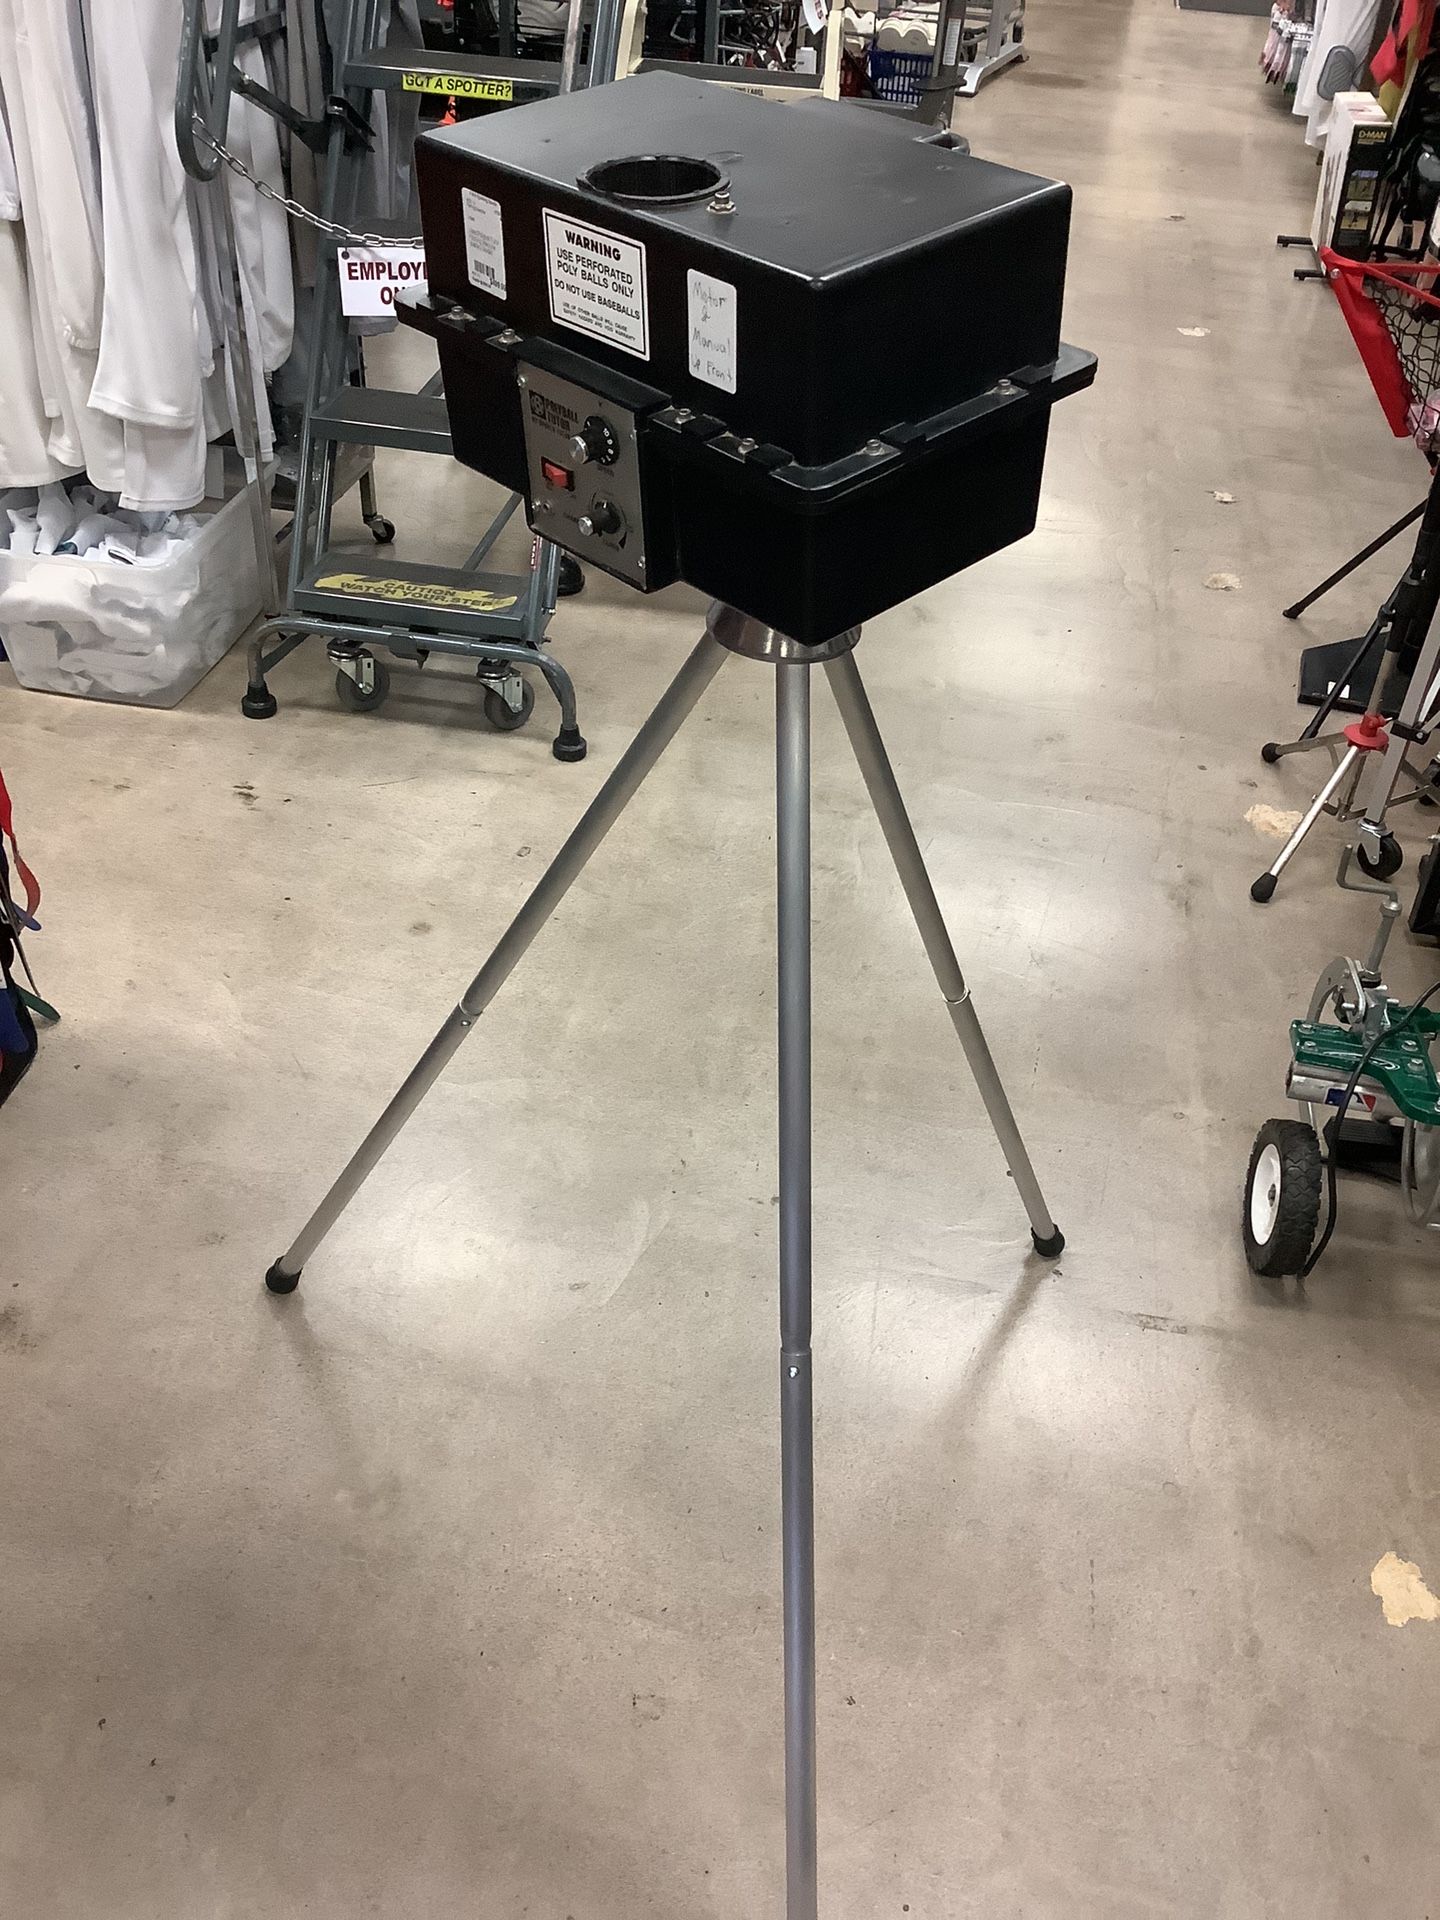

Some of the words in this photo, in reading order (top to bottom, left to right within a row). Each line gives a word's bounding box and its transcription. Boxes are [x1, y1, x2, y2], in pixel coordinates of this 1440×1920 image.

[434, 78, 443, 90] A
[446, 79, 512, 97] SPOTTER?
[1358, 130, 1387, 140] D-MAN
[565, 229, 621, 261] WARNING
[557, 247, 574, 263] USE
[576, 254, 633, 285] PERFORATED
[557, 260, 578, 277] POLY
[581, 269, 608, 289] BALLS
[612, 281, 634, 298] ONLY
[555, 278, 565, 290] DO
[566, 283, 580, 295] NOT
[582, 289, 596, 302] USE
[598, 295, 640, 320] BASEBALLS
[341, 582, 397, 595] WATCH
[402, 590, 446, 602] YOUR
[451, 597, 493, 607] STEP
[384, 583, 456, 597] CAUTION
